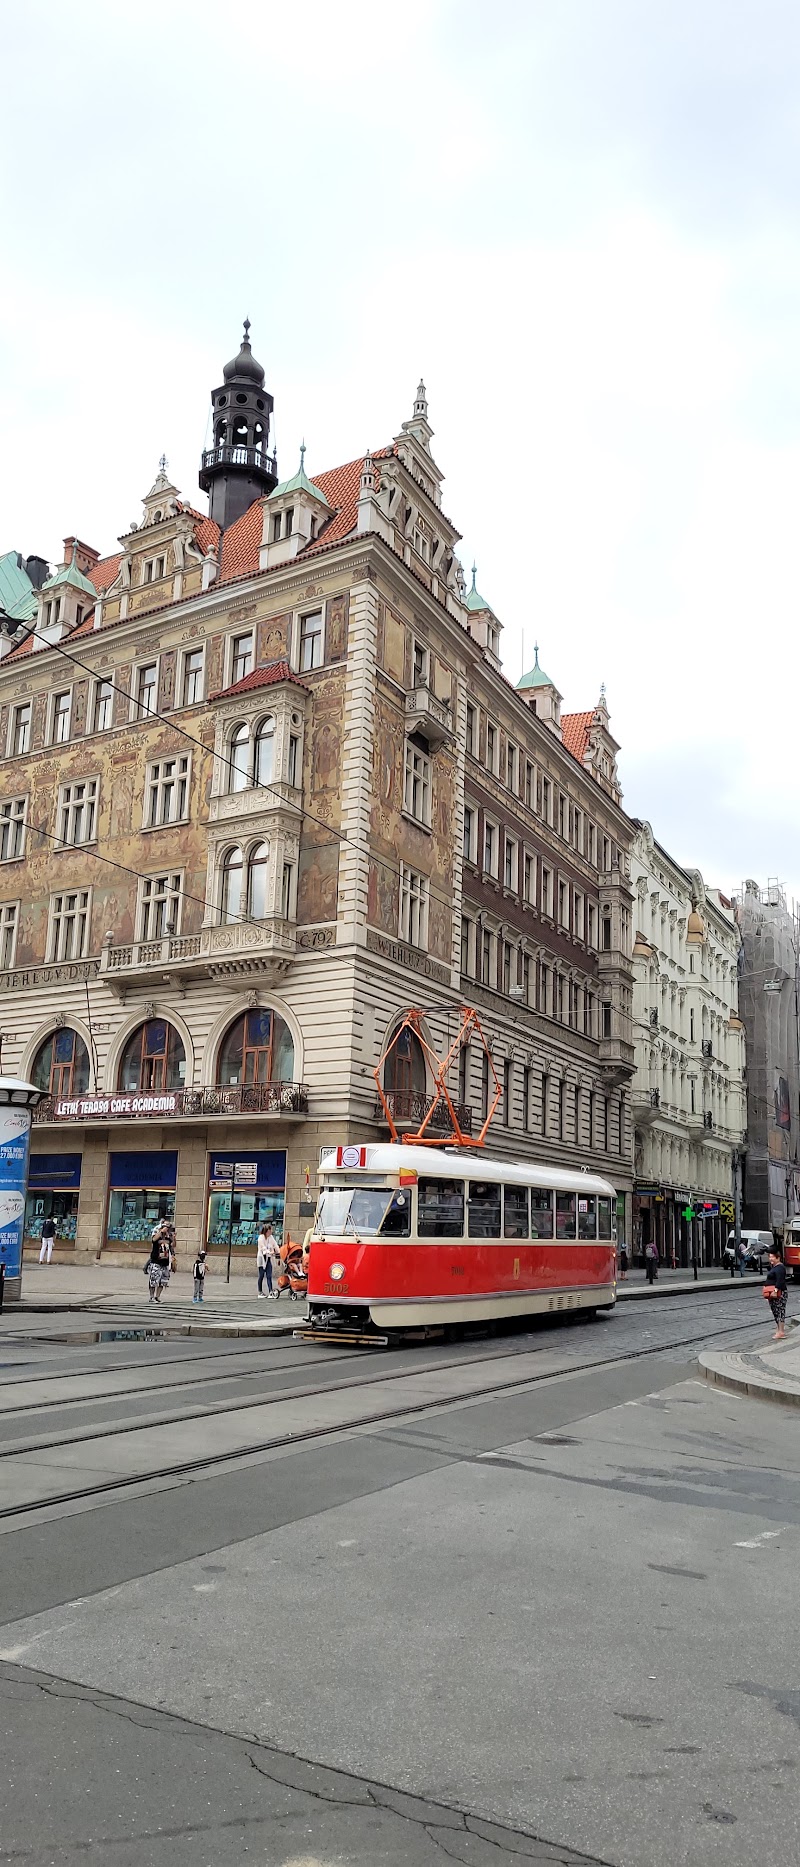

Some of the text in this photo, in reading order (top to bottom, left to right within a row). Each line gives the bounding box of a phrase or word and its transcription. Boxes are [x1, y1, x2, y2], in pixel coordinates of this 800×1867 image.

[80, 1100, 109, 1114] TERASA
[110, 1099, 132, 1112] CAFE
[132, 1097, 176, 1111] ACADEMIA
[323, 1283, 349, 1294] 5002
